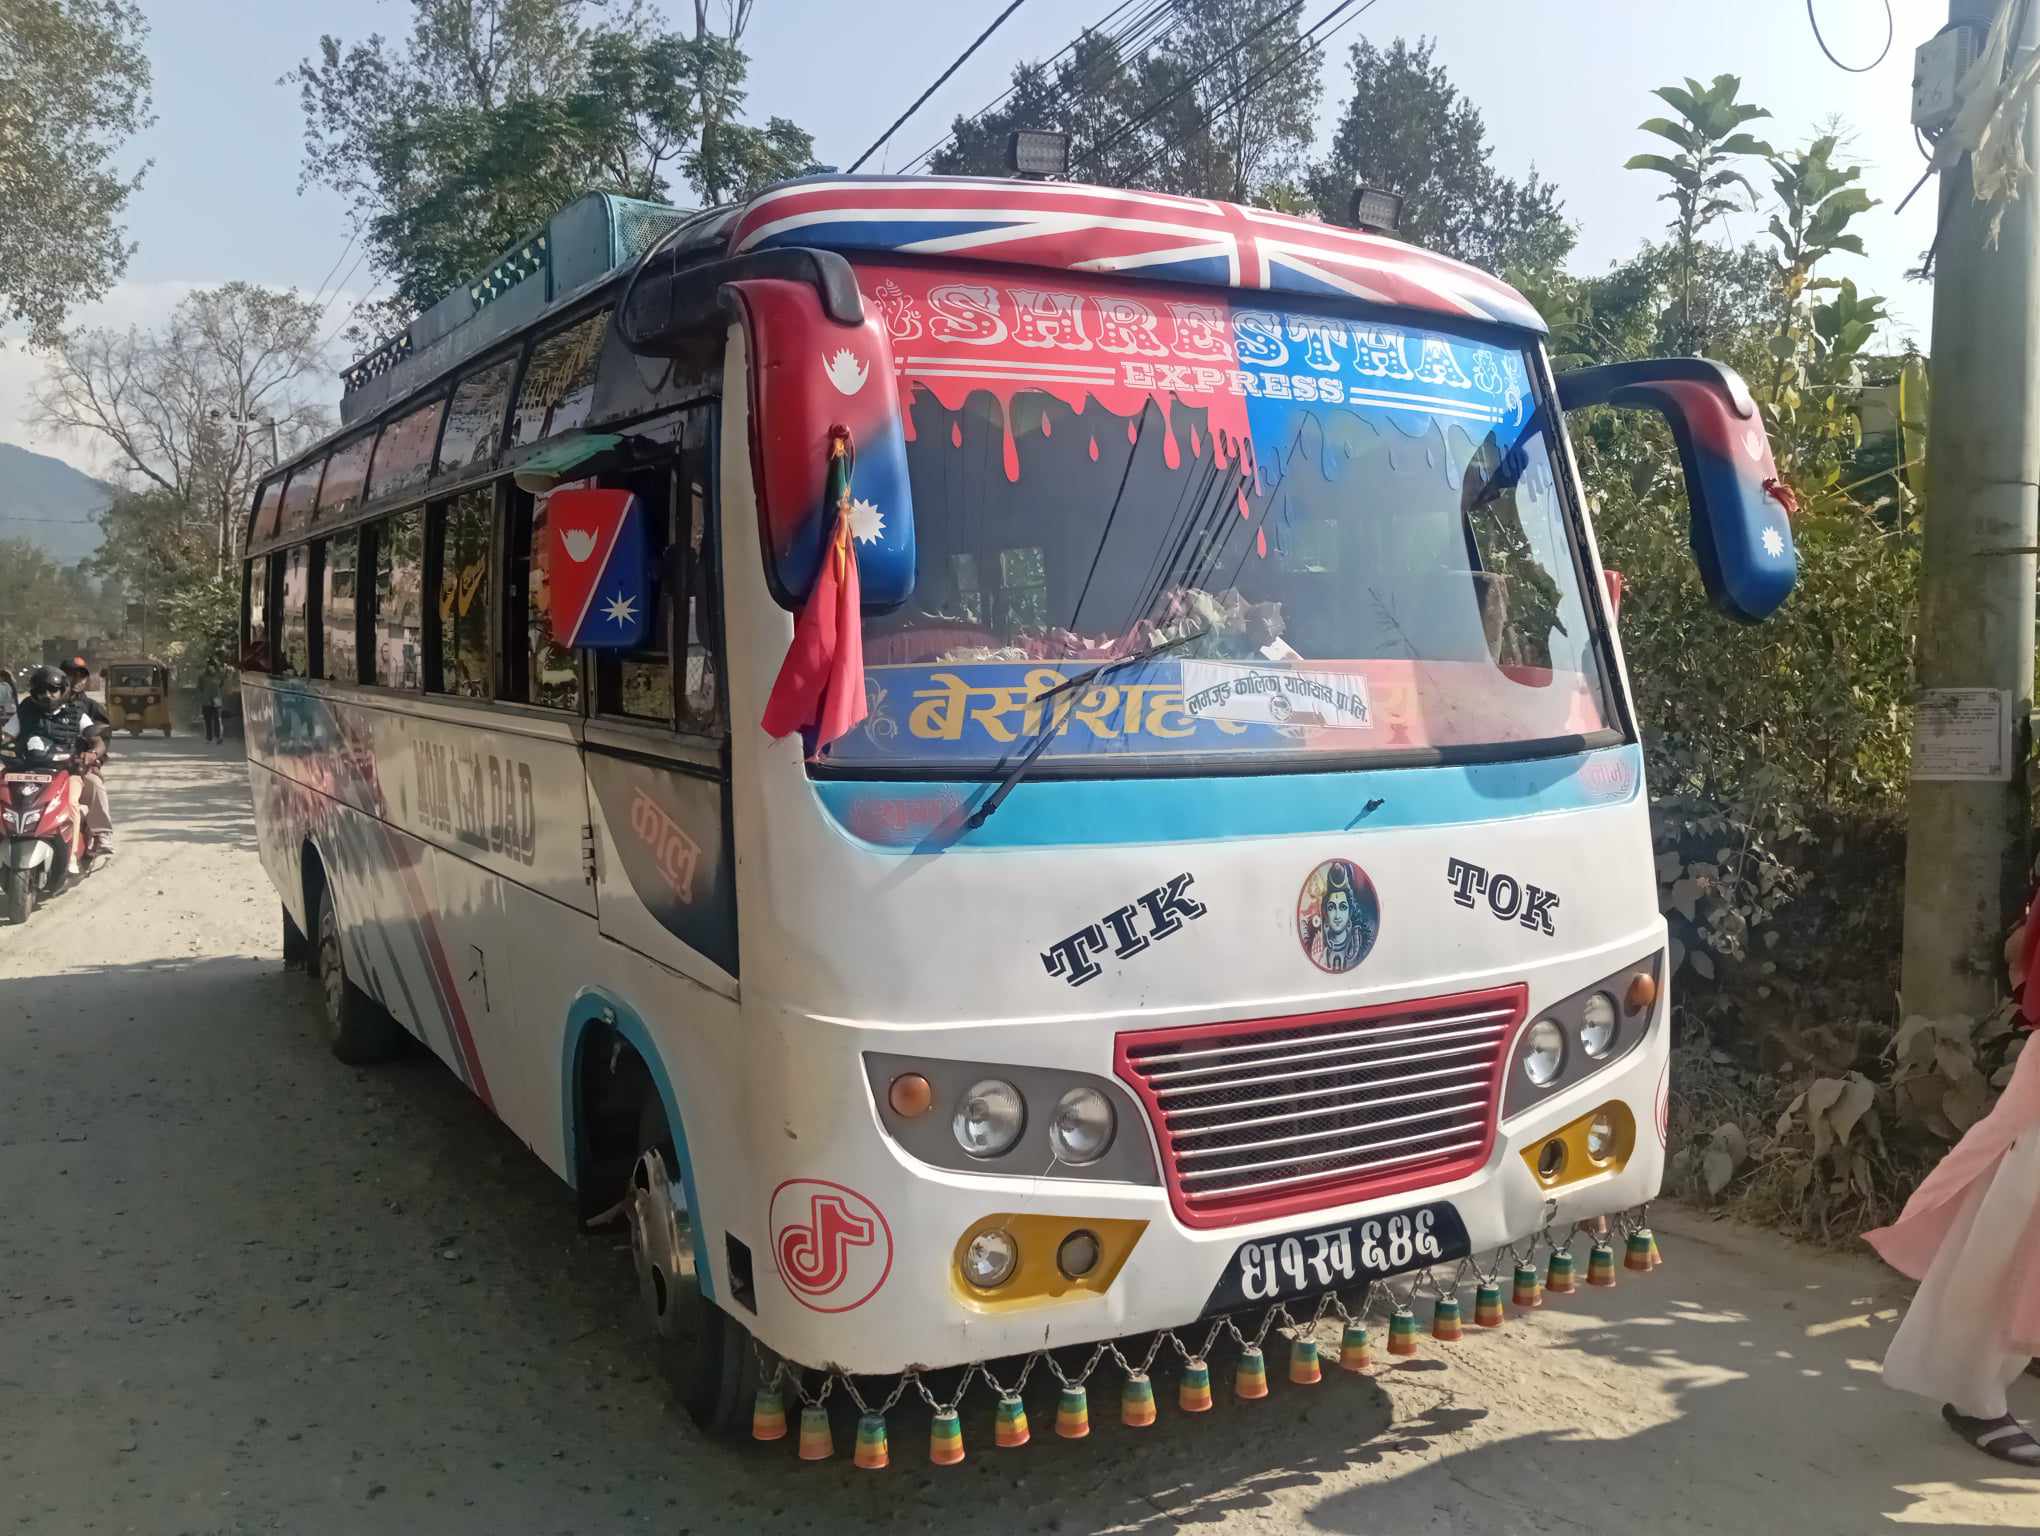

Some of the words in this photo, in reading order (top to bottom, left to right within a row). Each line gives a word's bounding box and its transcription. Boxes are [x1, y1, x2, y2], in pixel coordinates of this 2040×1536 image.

[926, 283, 1473, 389] SHRESTHA
[1120, 361, 1346, 403] EXPRESS
[908, 668, 1249, 743] बेसीशह
[1233, 670, 1281, 696] कालिका
[1039, 871, 1208, 987] TIK
[1447, 857, 1561, 936] TOK
